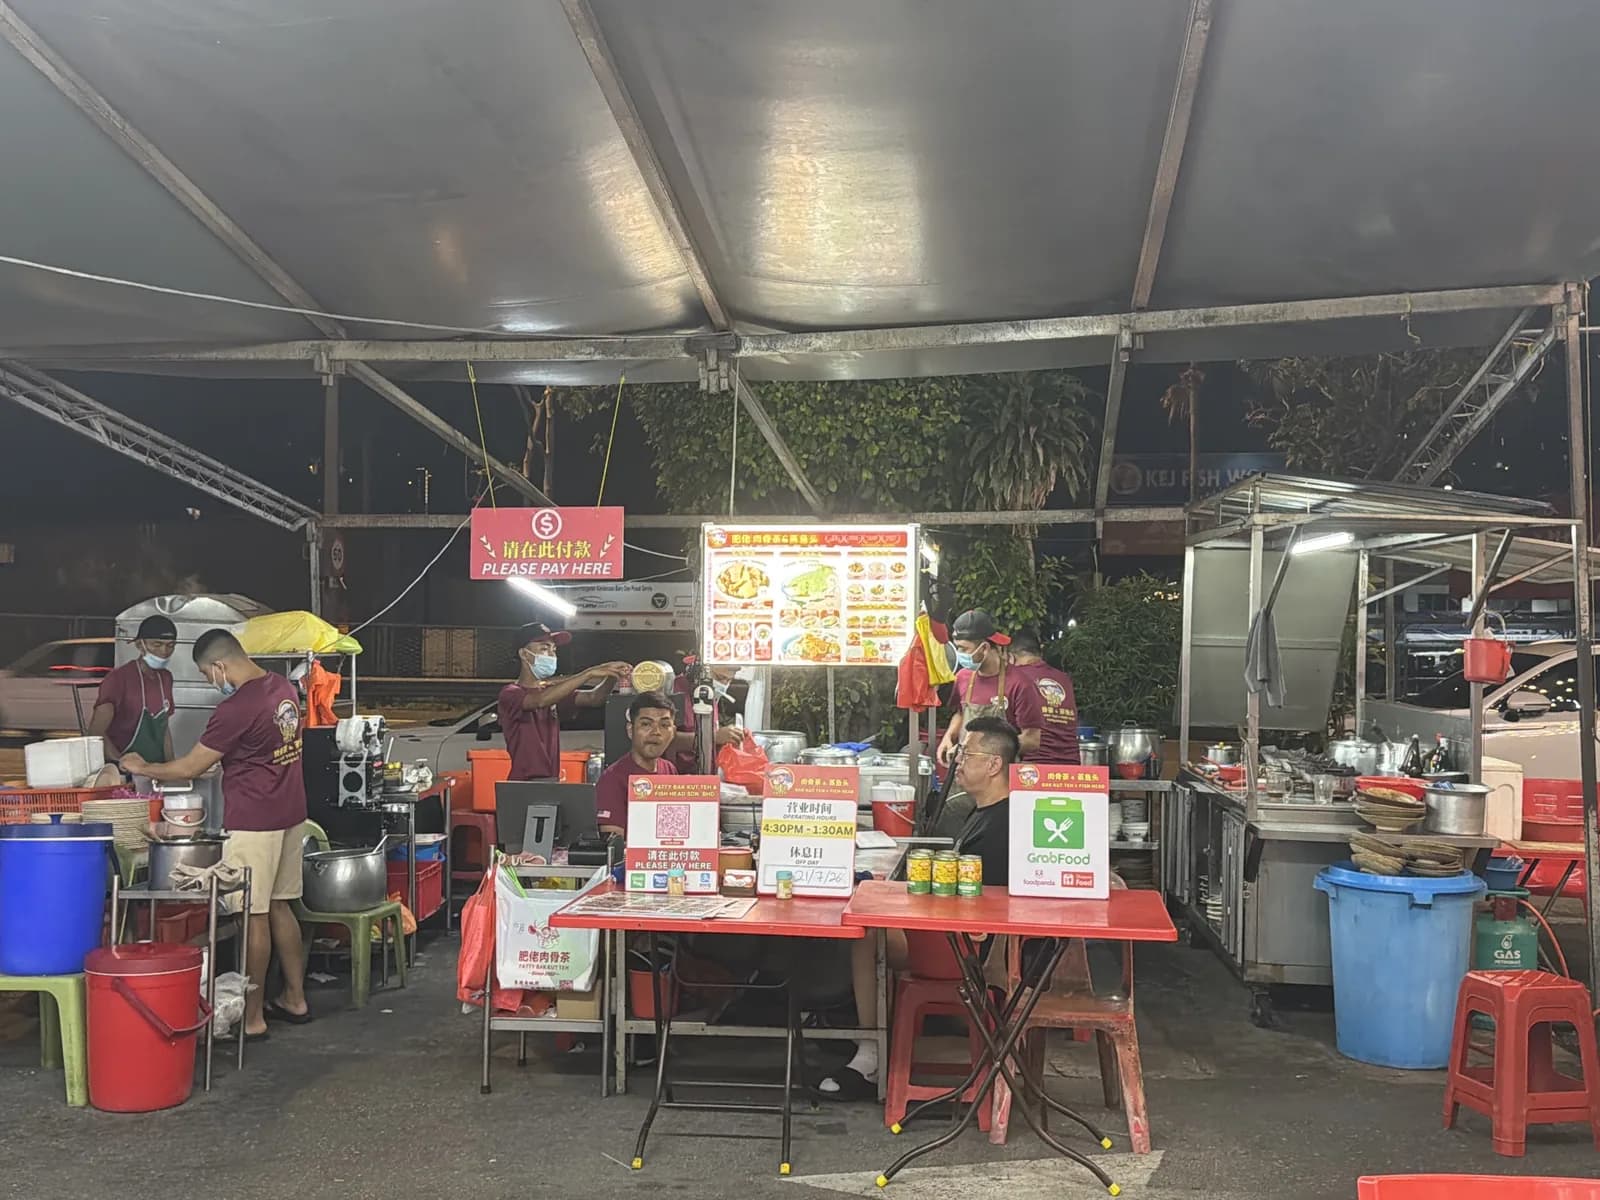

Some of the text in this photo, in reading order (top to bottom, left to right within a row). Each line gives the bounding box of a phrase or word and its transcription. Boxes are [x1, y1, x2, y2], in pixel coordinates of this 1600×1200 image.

[1182, 470, 1220, 487] FSH
[503, 541, 592, 559] 请在此付款
[482, 563, 613, 575] PLEASE PAY HERE
[786, 801, 832, 815] 营业时间
[763, 823, 803, 834] 4:30PM
[813, 825, 854, 836] 1:30AM
[648, 850, 700, 861] 请在此付款
[790, 846, 823, 859] 休息日
[1027, 851, 1091, 865] GrabFood
[635, 861, 712, 870] PLEASE PAY HERE
[518, 951, 570, 963] 肥佬肉骨茶
[1494, 950, 1521, 959] GAS
